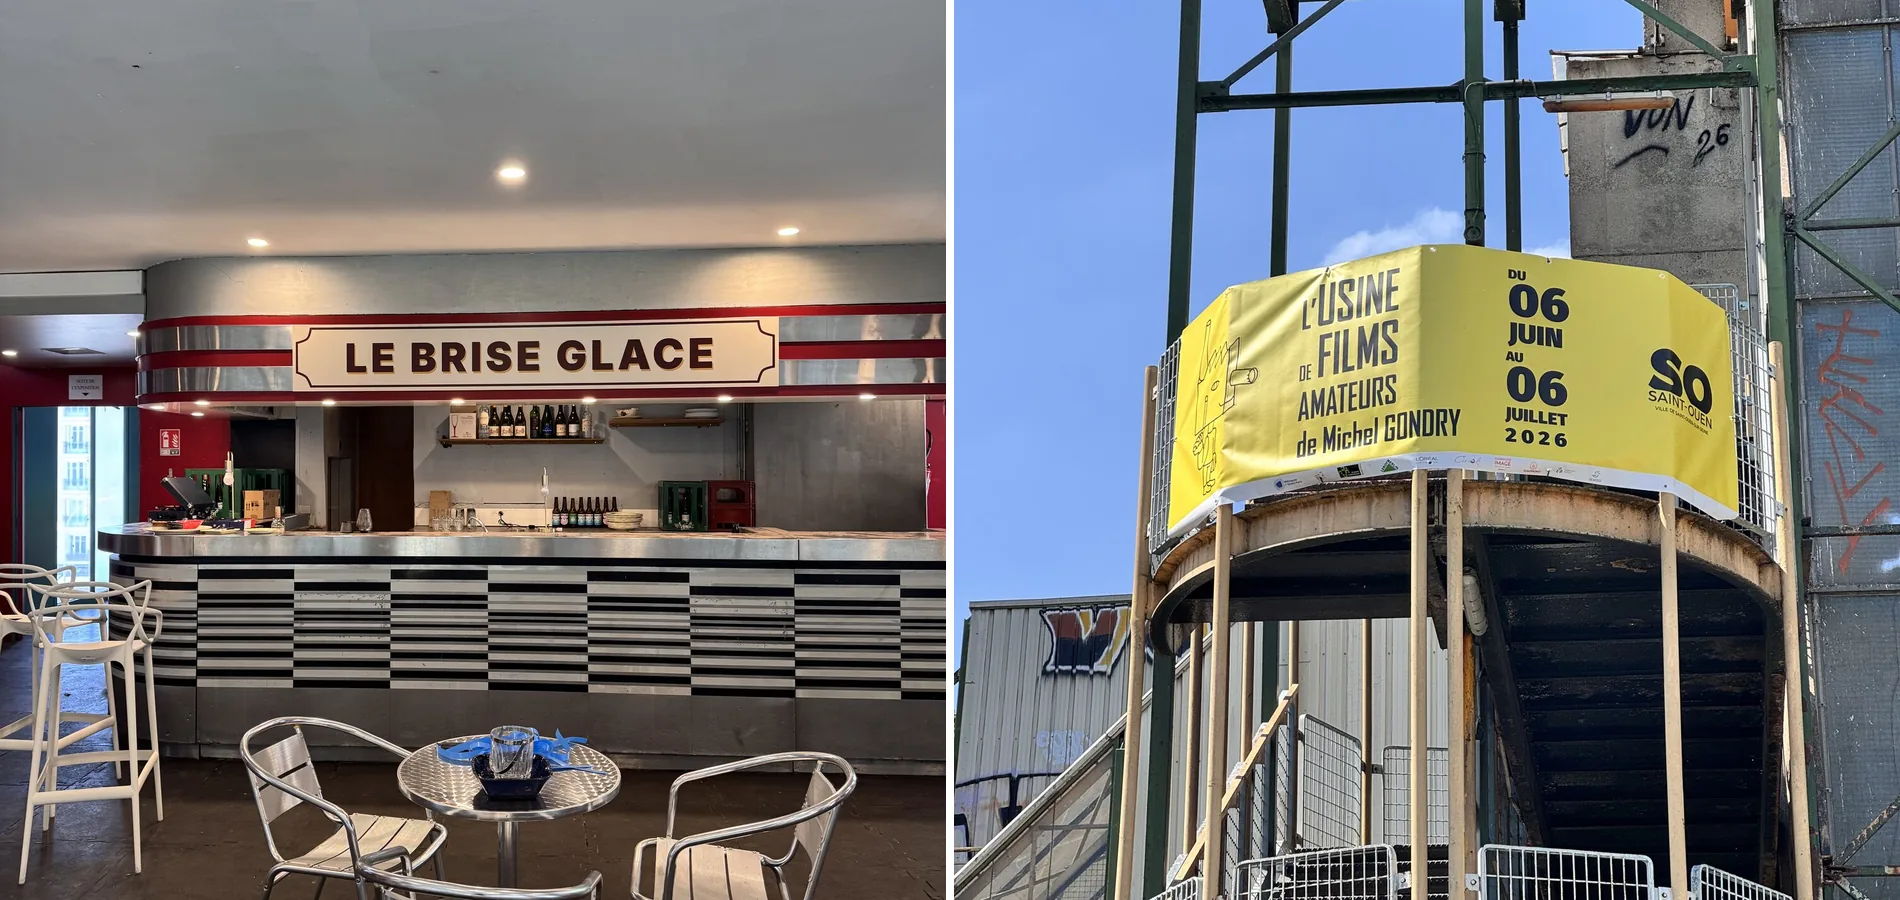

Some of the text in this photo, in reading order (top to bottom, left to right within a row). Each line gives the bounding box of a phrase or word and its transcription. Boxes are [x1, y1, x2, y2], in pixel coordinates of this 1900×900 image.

[1508, 269, 1526, 281] DU
[1302, 268, 1400, 330] L'USINE
[1509, 284, 1569, 322] 06
[1299, 319, 1399, 382] DE FILMS
[1508, 322, 1563, 348] JUIN
[346, 337, 714, 373] LE BRISE GLACE
[1506, 351, 1524, 362] AU
[1298, 374, 1397, 422] AMATEURS
[1507, 366, 1568, 407] 06
[1649, 348, 1712, 415] SO
[1505, 407, 1568, 426] JUILLET
[1648, 390, 1712, 429] SAINT-OUEN
[1296, 409, 1461, 458] de Michel GONDRY
[1505, 428, 1568, 447] 2026
